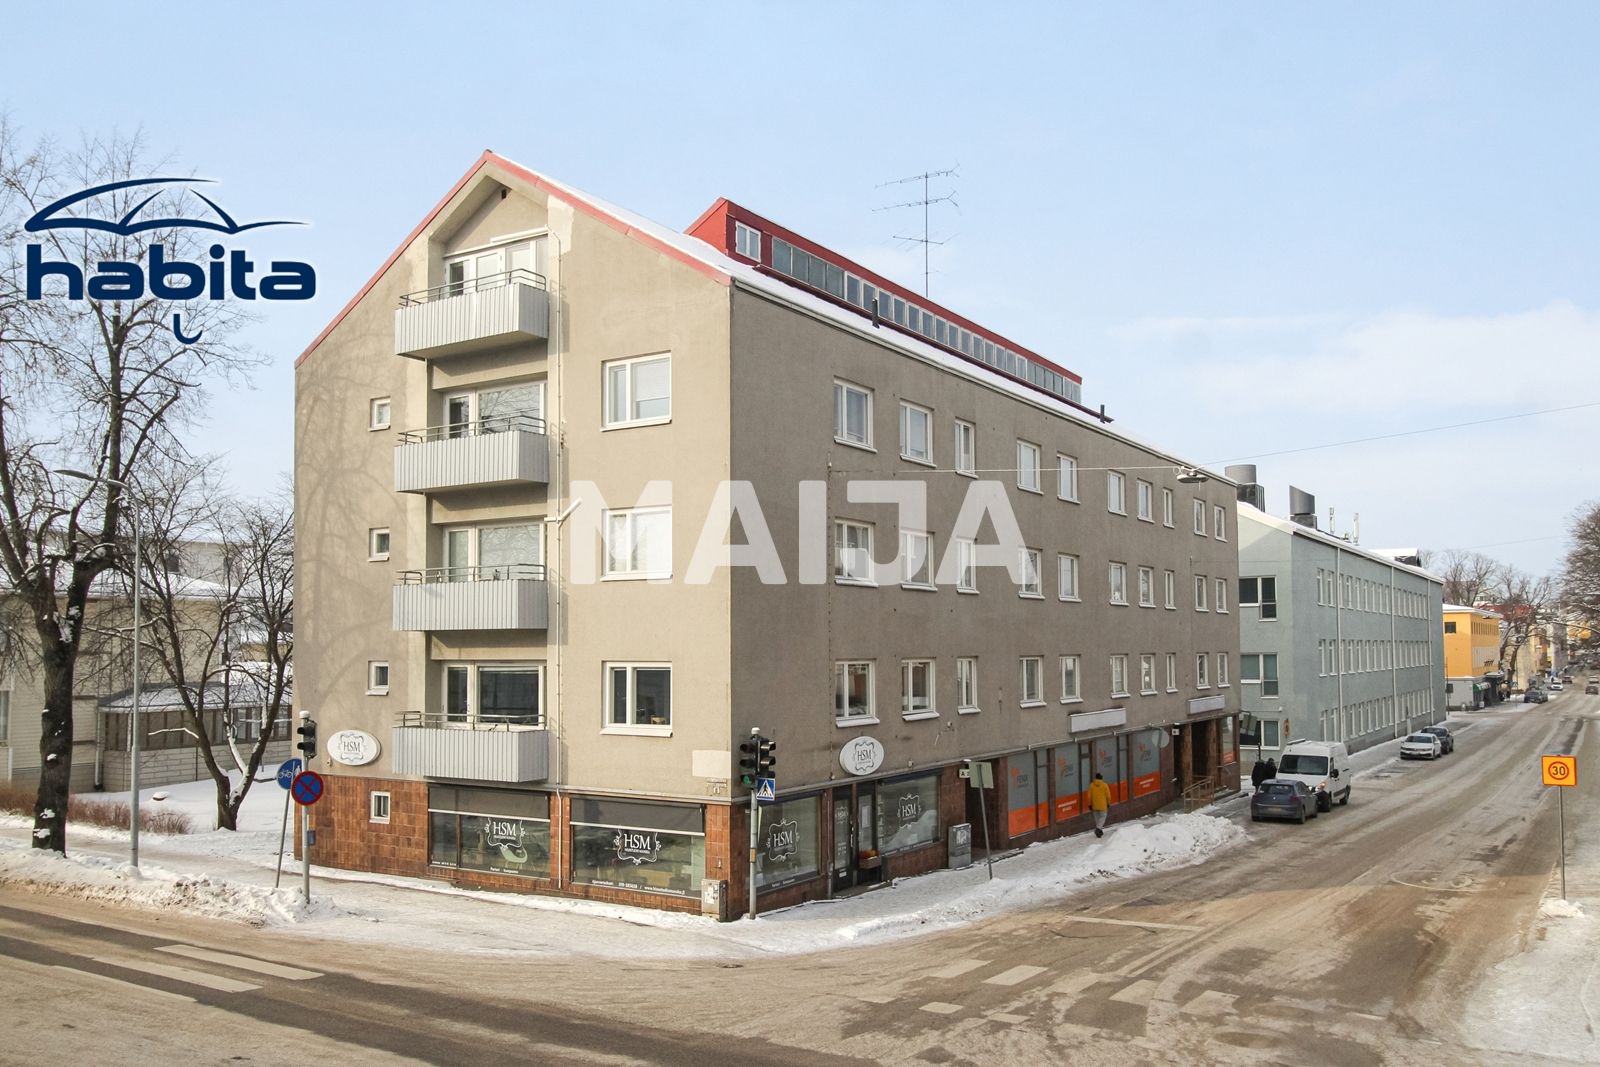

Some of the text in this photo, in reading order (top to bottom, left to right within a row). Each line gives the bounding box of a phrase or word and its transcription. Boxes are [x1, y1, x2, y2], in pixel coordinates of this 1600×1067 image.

[343, 741, 361, 752] HSM
[856, 749, 872, 761] HSM
[1552, 766, 1566, 775] 30
[902, 803, 916, 817] HSM
[493, 821, 517, 836] HSM
[623, 833, 651, 850] HSM
[773, 830, 793, 848] HSM
